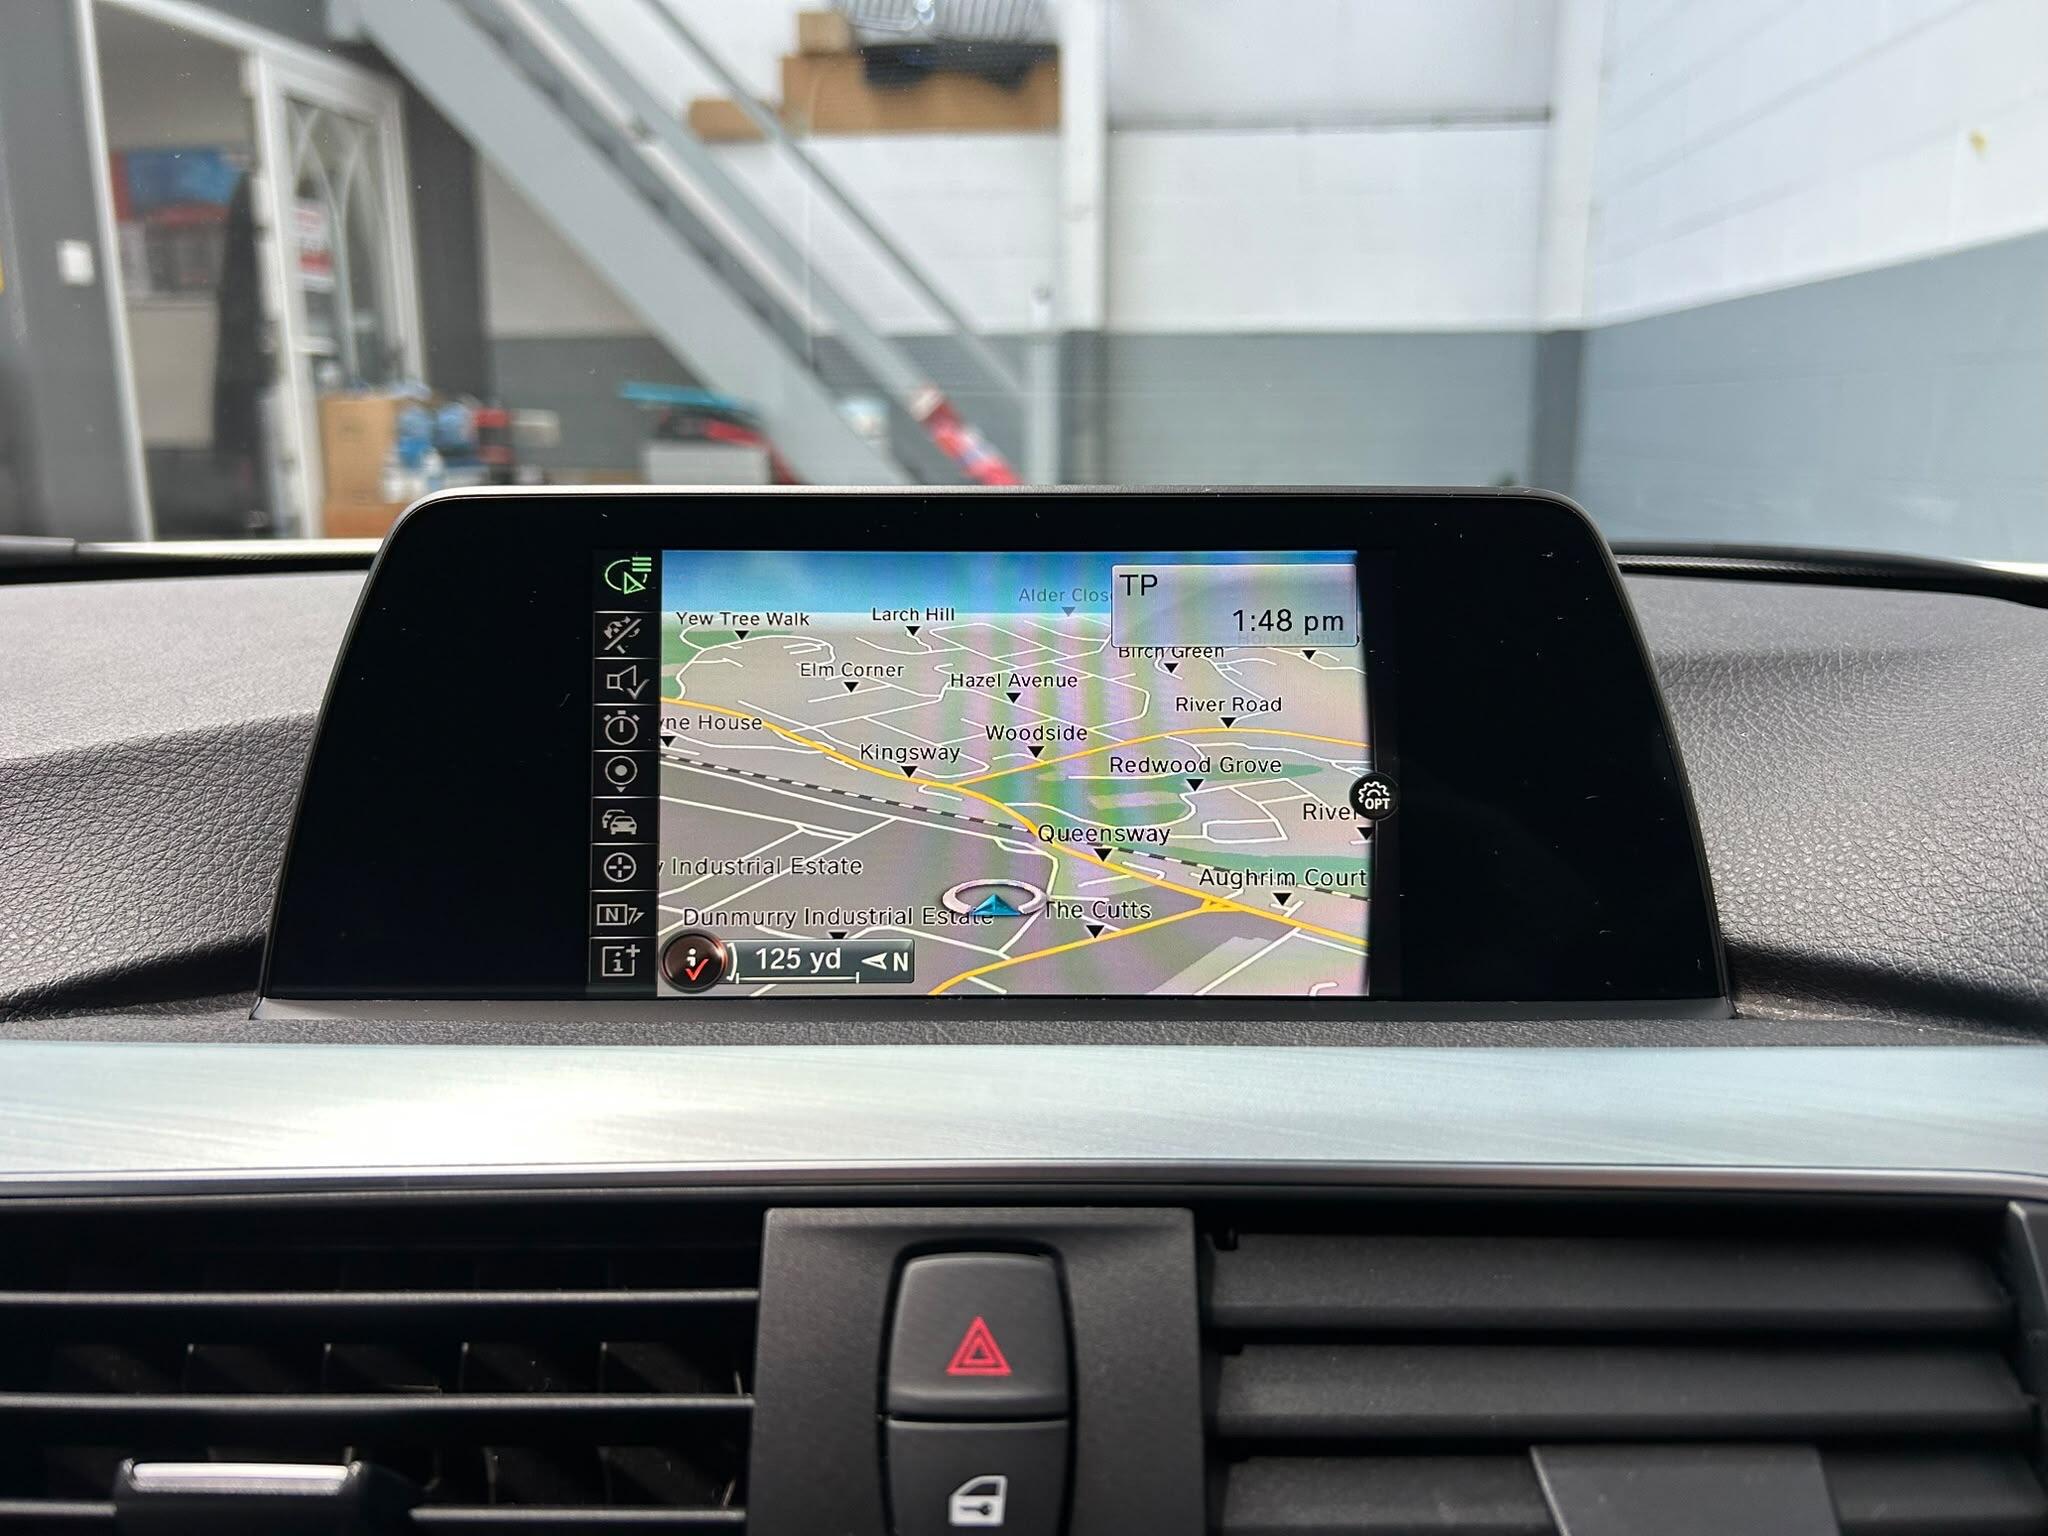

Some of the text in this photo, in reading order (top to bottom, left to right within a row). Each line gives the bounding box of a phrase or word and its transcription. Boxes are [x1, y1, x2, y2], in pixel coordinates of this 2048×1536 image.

[1119, 574, 1158, 596] TP
[1019, 588, 1111, 602] Alder Clos
[676, 612, 810, 627] Yew Tree Walk
[872, 607, 955, 622] Larch Hill
[1232, 609, 1344, 636] 1:48 pm
[1171, 647, 1224, 658] Green
[800, 663, 905, 678] Elm Corner
[951, 673, 1078, 688] Hazel Avenue
[1176, 697, 1282, 712] River Road
[698, 714, 762, 730] House
[986, 725, 1088, 741] Woodside
[860, 744, 960, 765] Kingsway
[1110, 757, 1282, 773] Redwood Grove
[1365, 798, 1391, 810] OPT
[1037, 825, 1171, 846] Queensway
[672, 857, 781, 875] Industrial
[790, 857, 863, 875] Estate
[1199, 868, 1368, 890] Aughrim Court
[1045, 901, 1152, 918] The Cutts
[684, 907, 994, 929] Dunmurry Industrial Estate
[755, 947, 909, 974] 125 yd N
